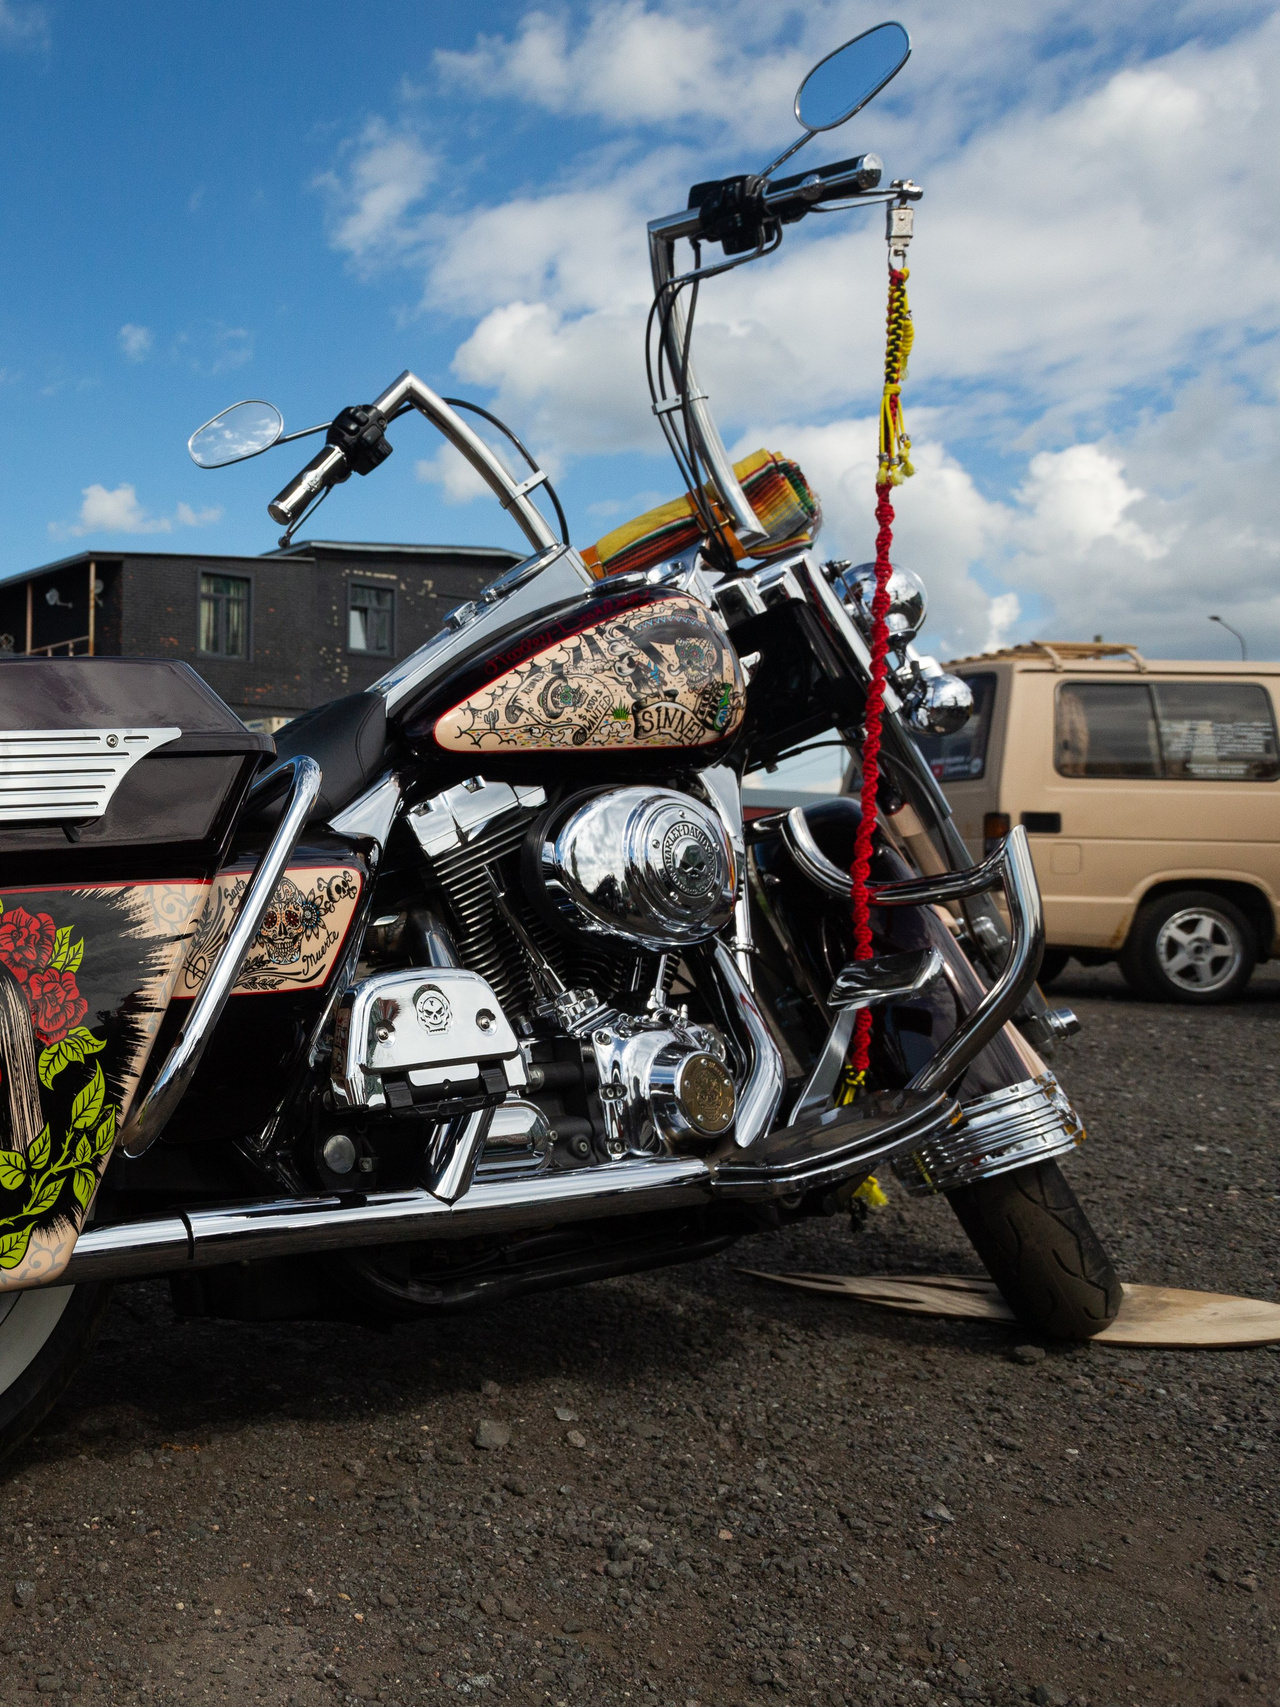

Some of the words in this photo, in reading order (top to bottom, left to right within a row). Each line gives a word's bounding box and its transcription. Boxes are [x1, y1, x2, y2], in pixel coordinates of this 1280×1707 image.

[582, 695, 612, 732] WANTED
[640, 705, 706, 745] SINNER
[665, 824, 715, 867] HARLEY-DAVIDSON
[301, 930, 340, 976] Muerte
